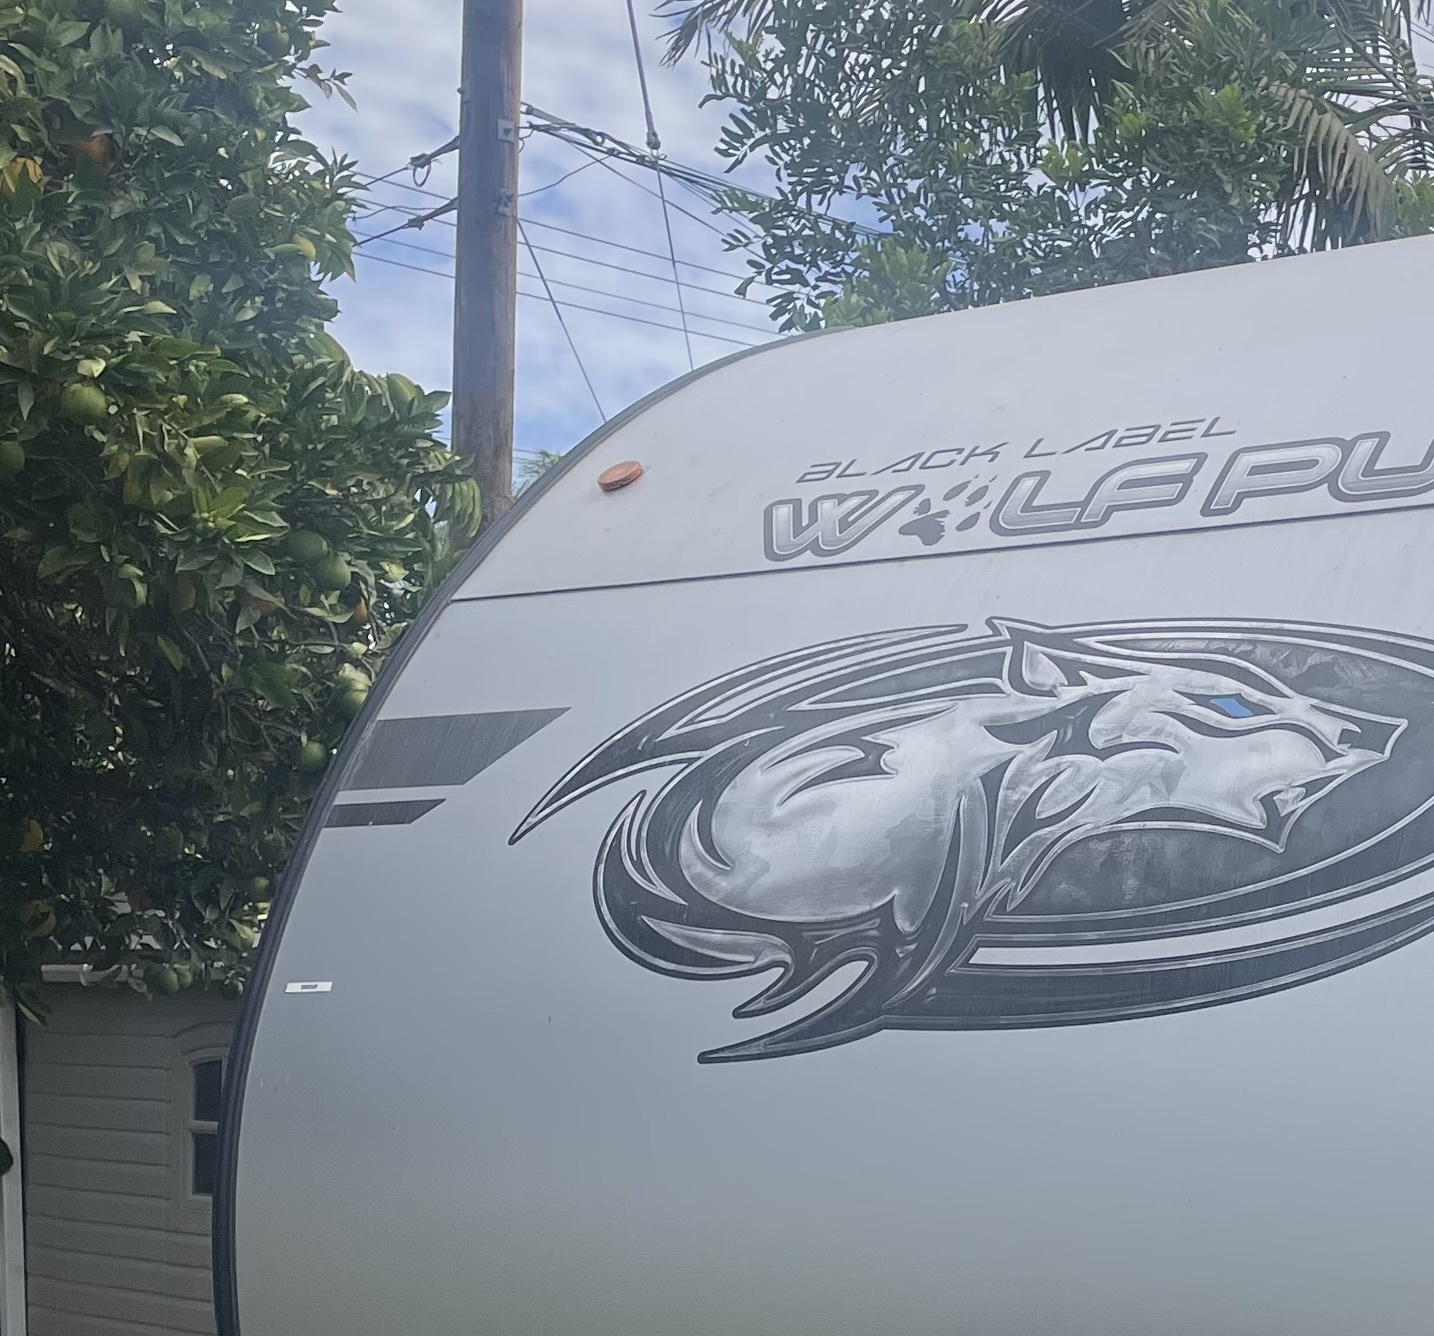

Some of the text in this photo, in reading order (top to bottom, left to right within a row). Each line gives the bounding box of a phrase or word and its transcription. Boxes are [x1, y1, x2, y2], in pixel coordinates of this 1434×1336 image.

[796, 416, 1237, 483] BLACK LABEL
[763, 449, 1208, 562] WLF
